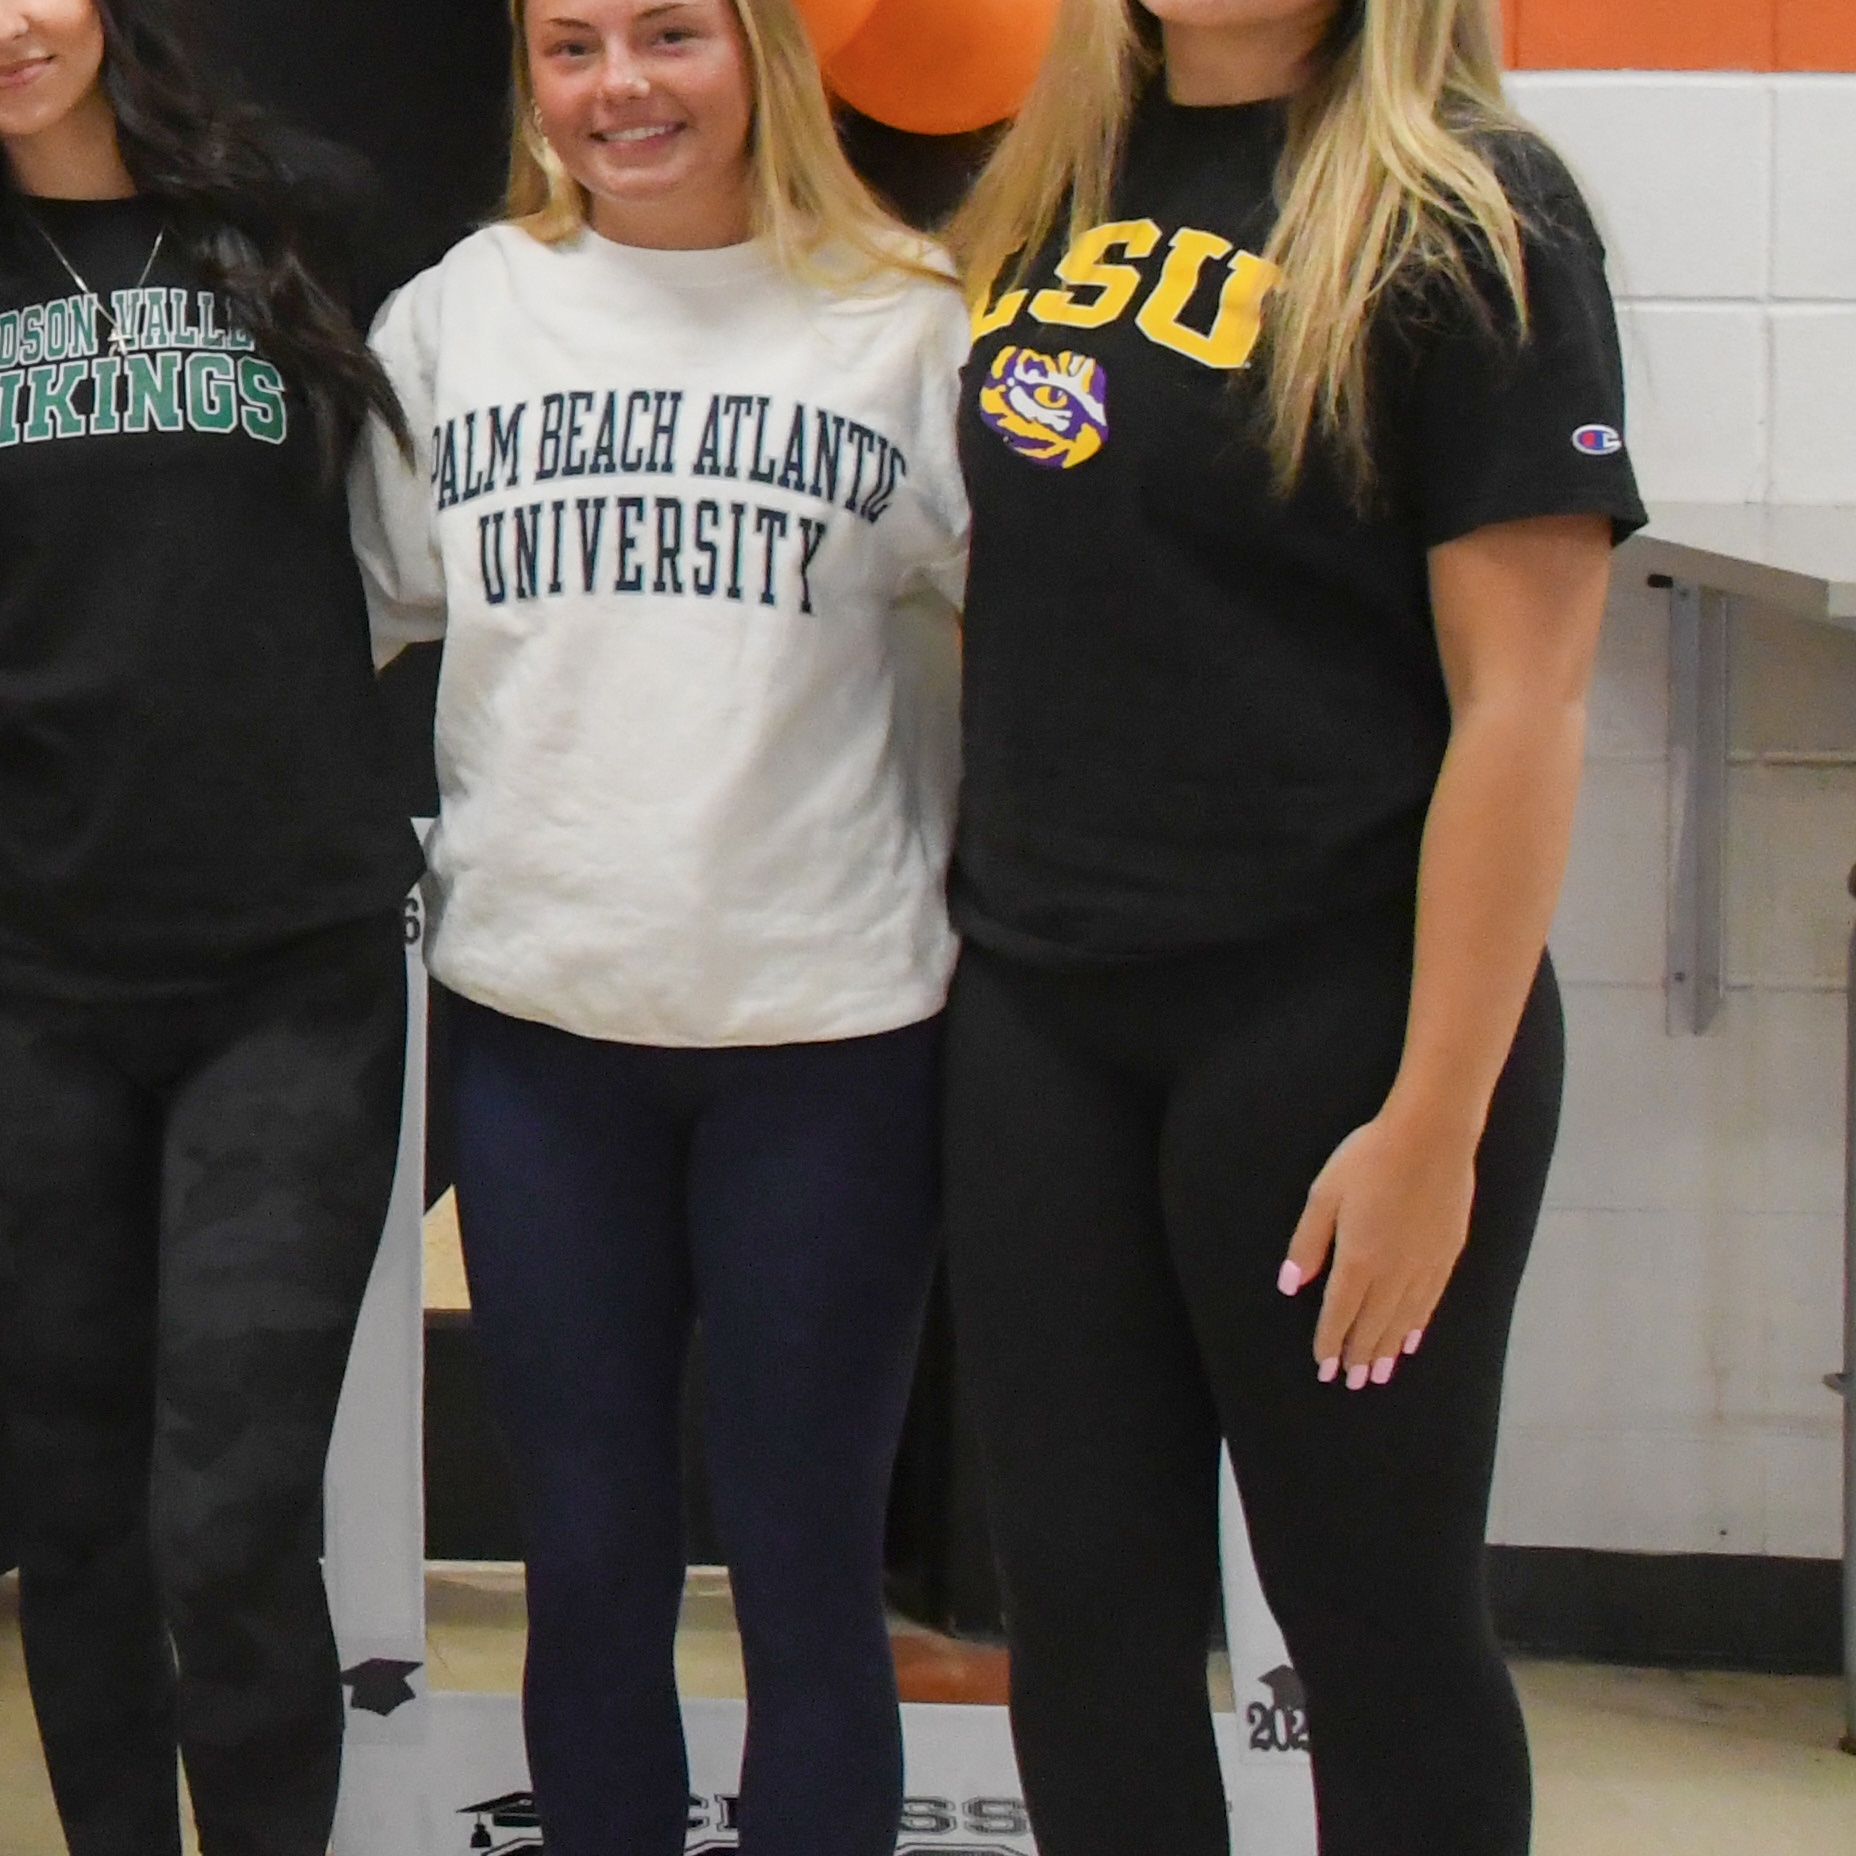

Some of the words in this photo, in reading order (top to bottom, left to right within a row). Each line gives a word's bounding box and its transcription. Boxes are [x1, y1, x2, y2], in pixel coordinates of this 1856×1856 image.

[534, 388, 684, 481] BEACH
[692, 394, 906, 524] ATLANTIC
[478, 496, 826, 615] UNIVERSITY
